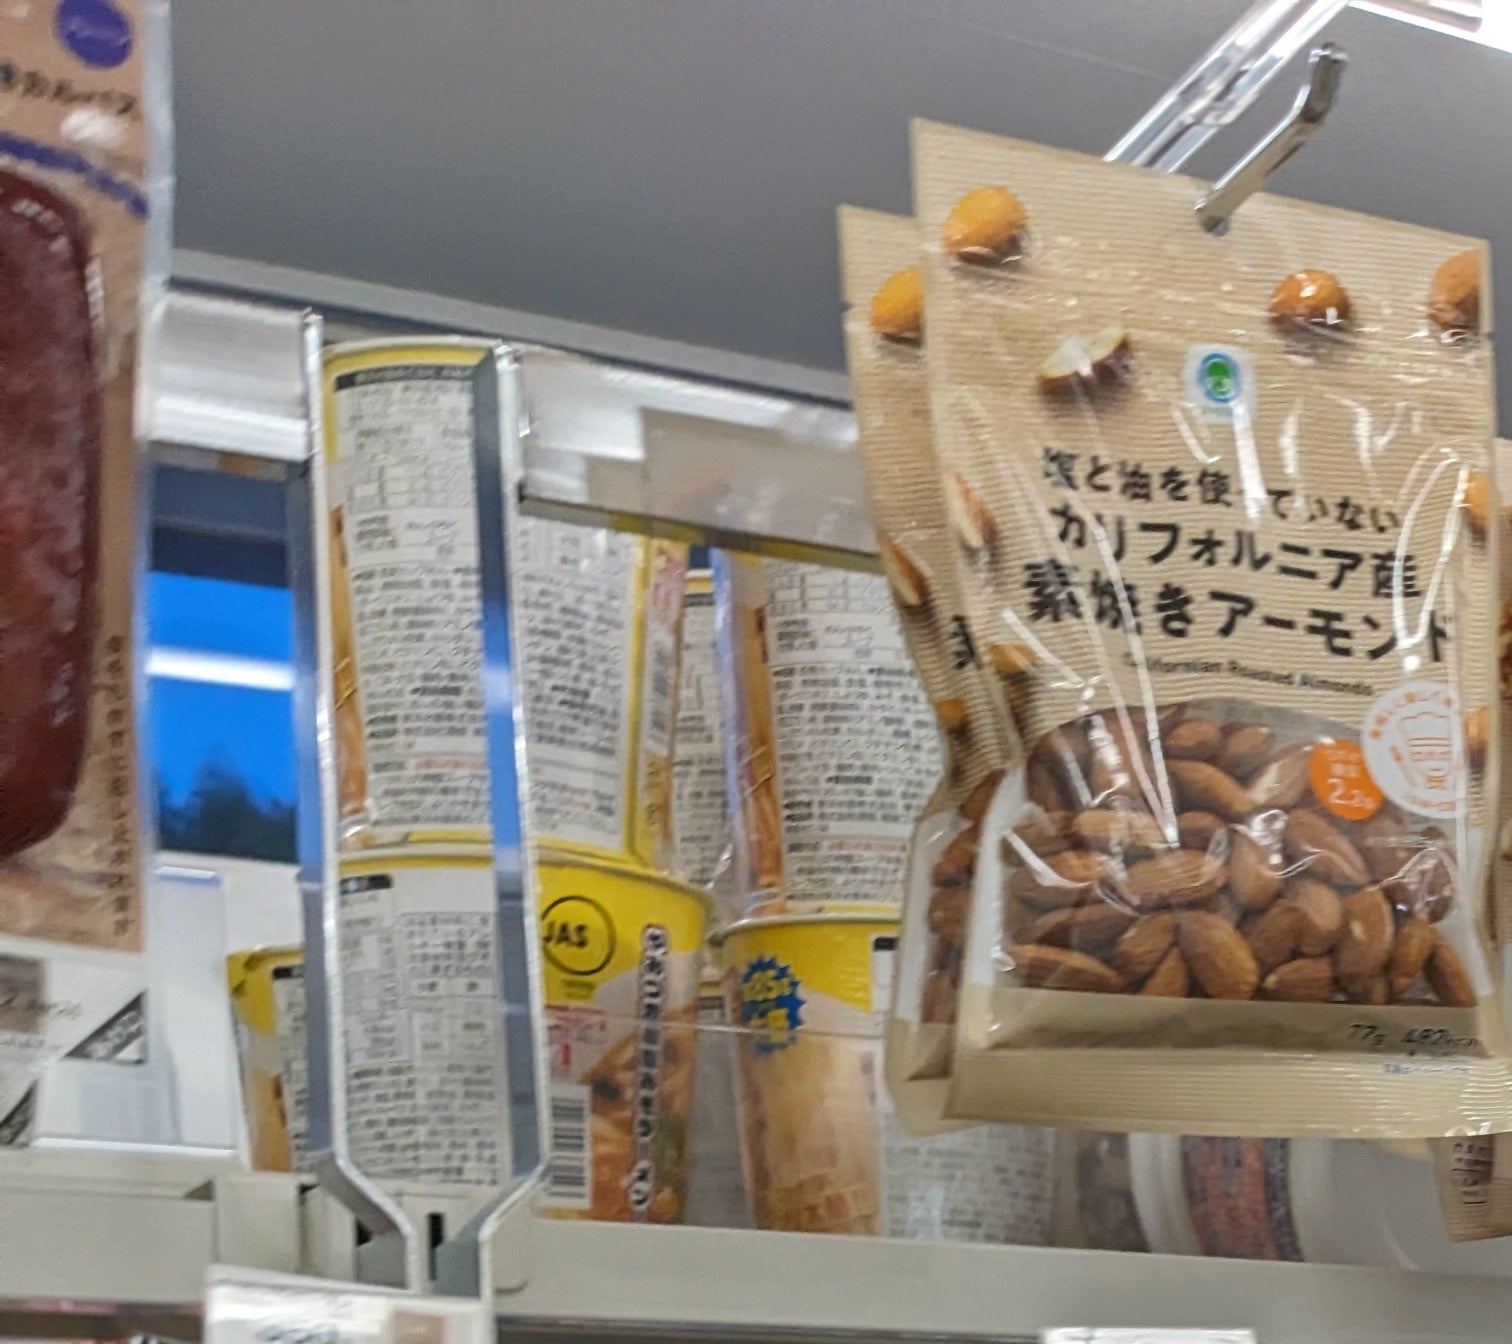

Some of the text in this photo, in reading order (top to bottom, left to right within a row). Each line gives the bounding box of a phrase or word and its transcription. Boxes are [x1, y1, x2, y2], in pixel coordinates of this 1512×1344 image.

[1048, 502, 1421, 598] カリフォルニア産
[1022, 558, 1453, 663] 素焼きアーモンド
